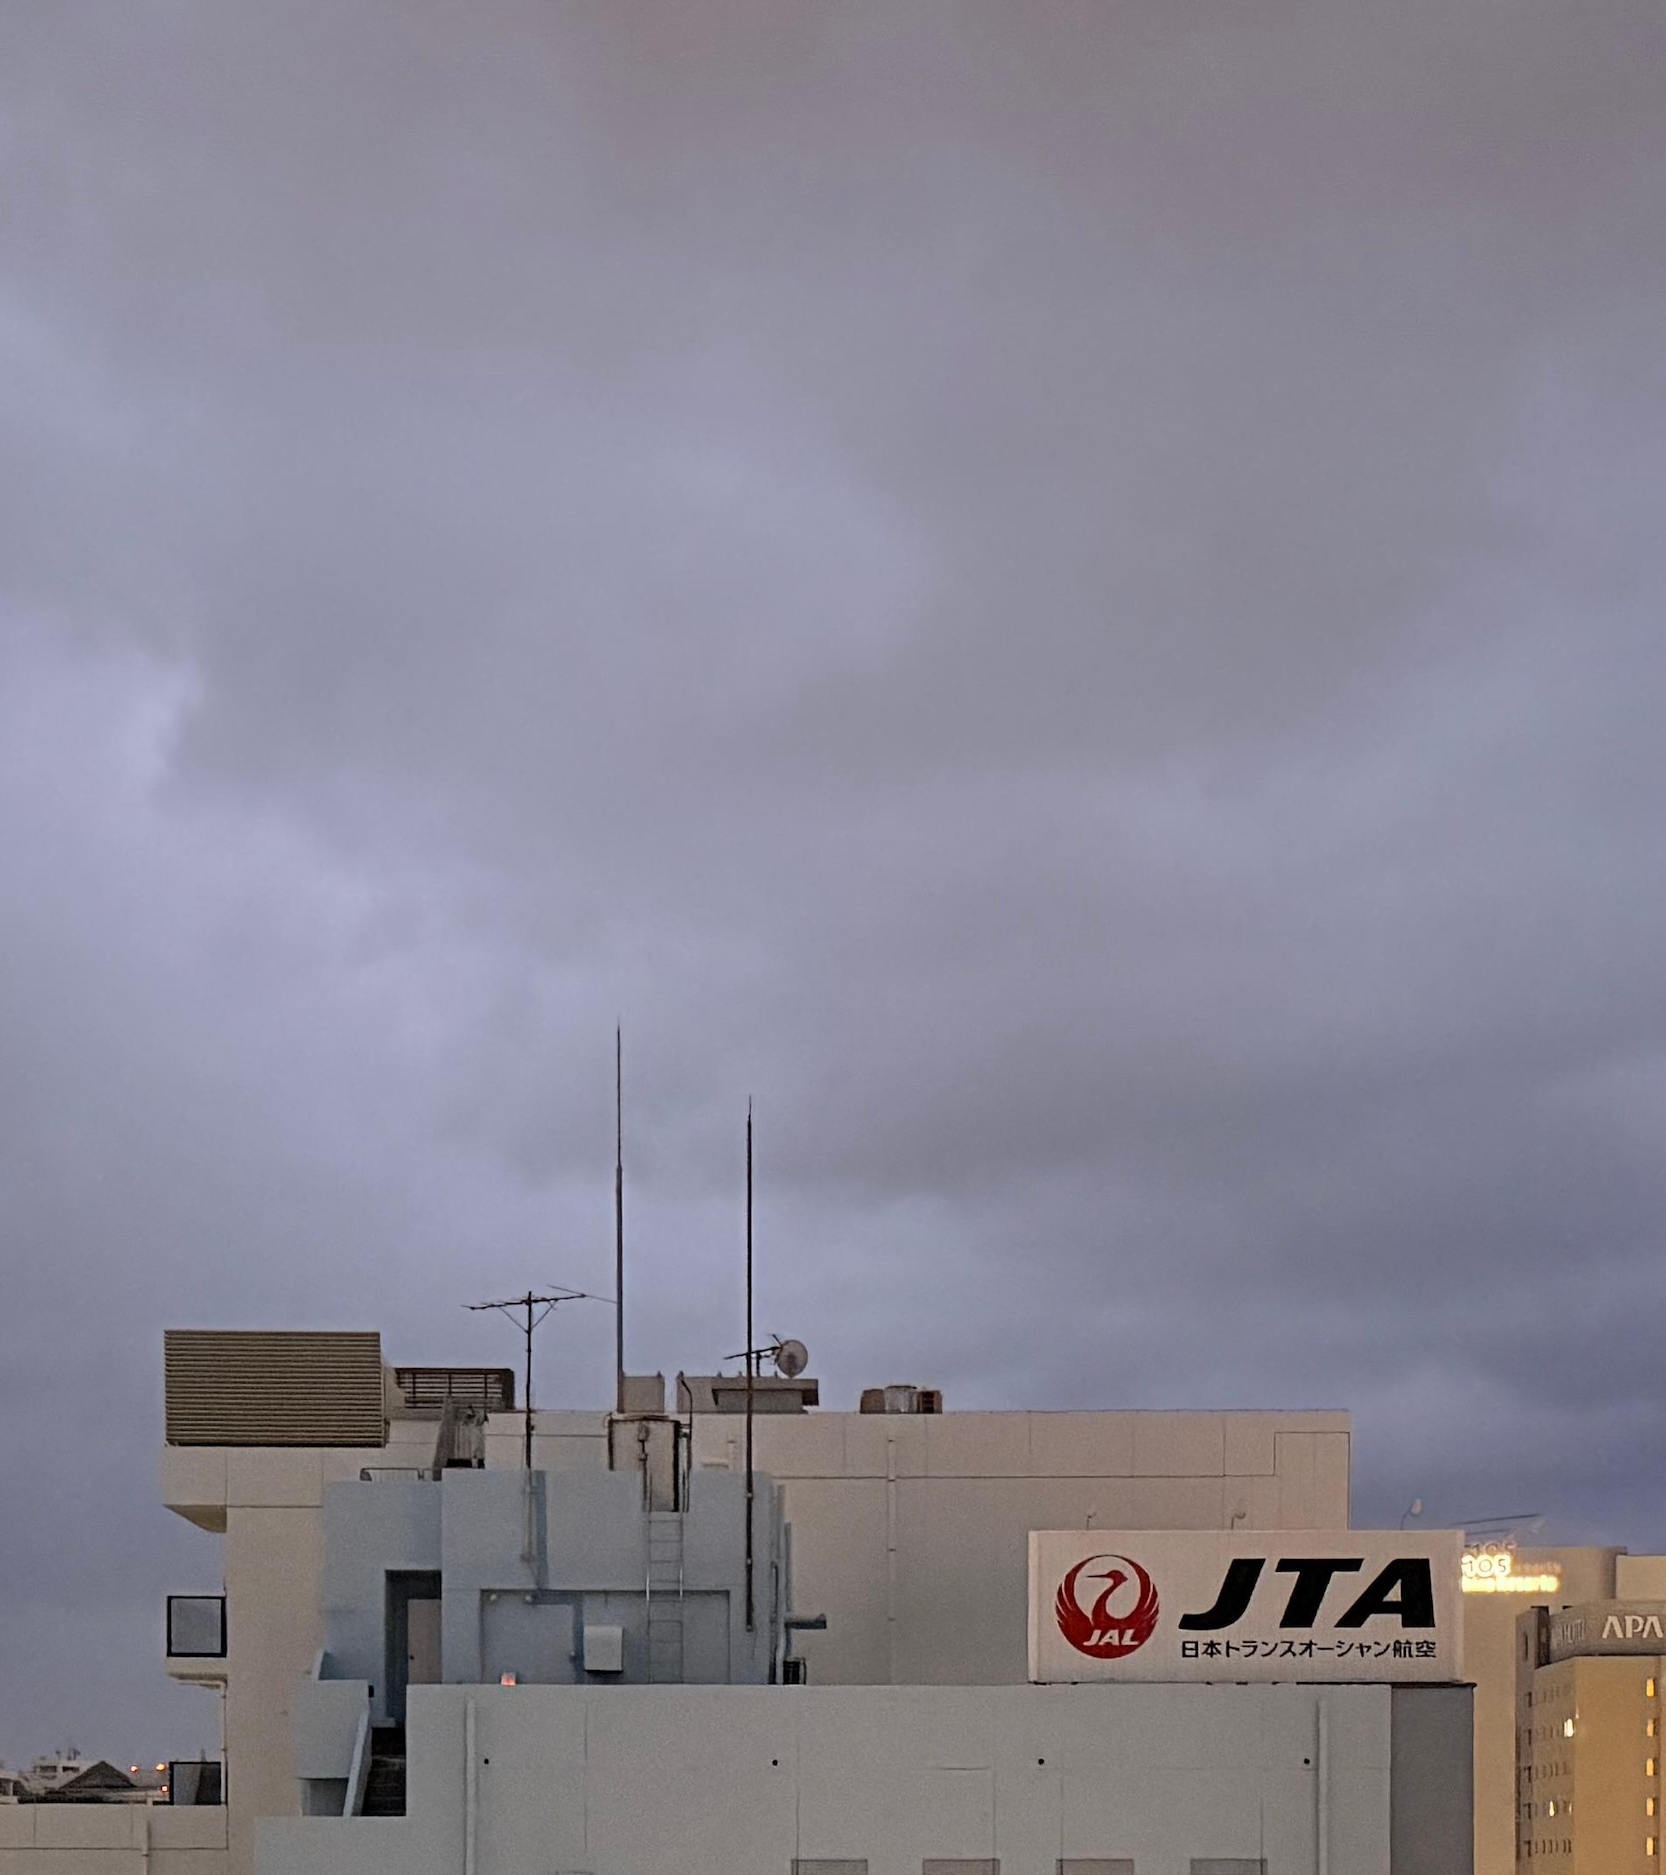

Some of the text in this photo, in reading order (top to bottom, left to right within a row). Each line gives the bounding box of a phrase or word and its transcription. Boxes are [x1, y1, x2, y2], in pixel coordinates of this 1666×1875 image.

[1178, 1557, 1435, 1629] JTA
[1084, 1629, 1139, 1646] JAL
[1601, 1615, 1664, 1639] APA
[1181, 1639, 1436, 1659] 日本トランスオーシャン航空
